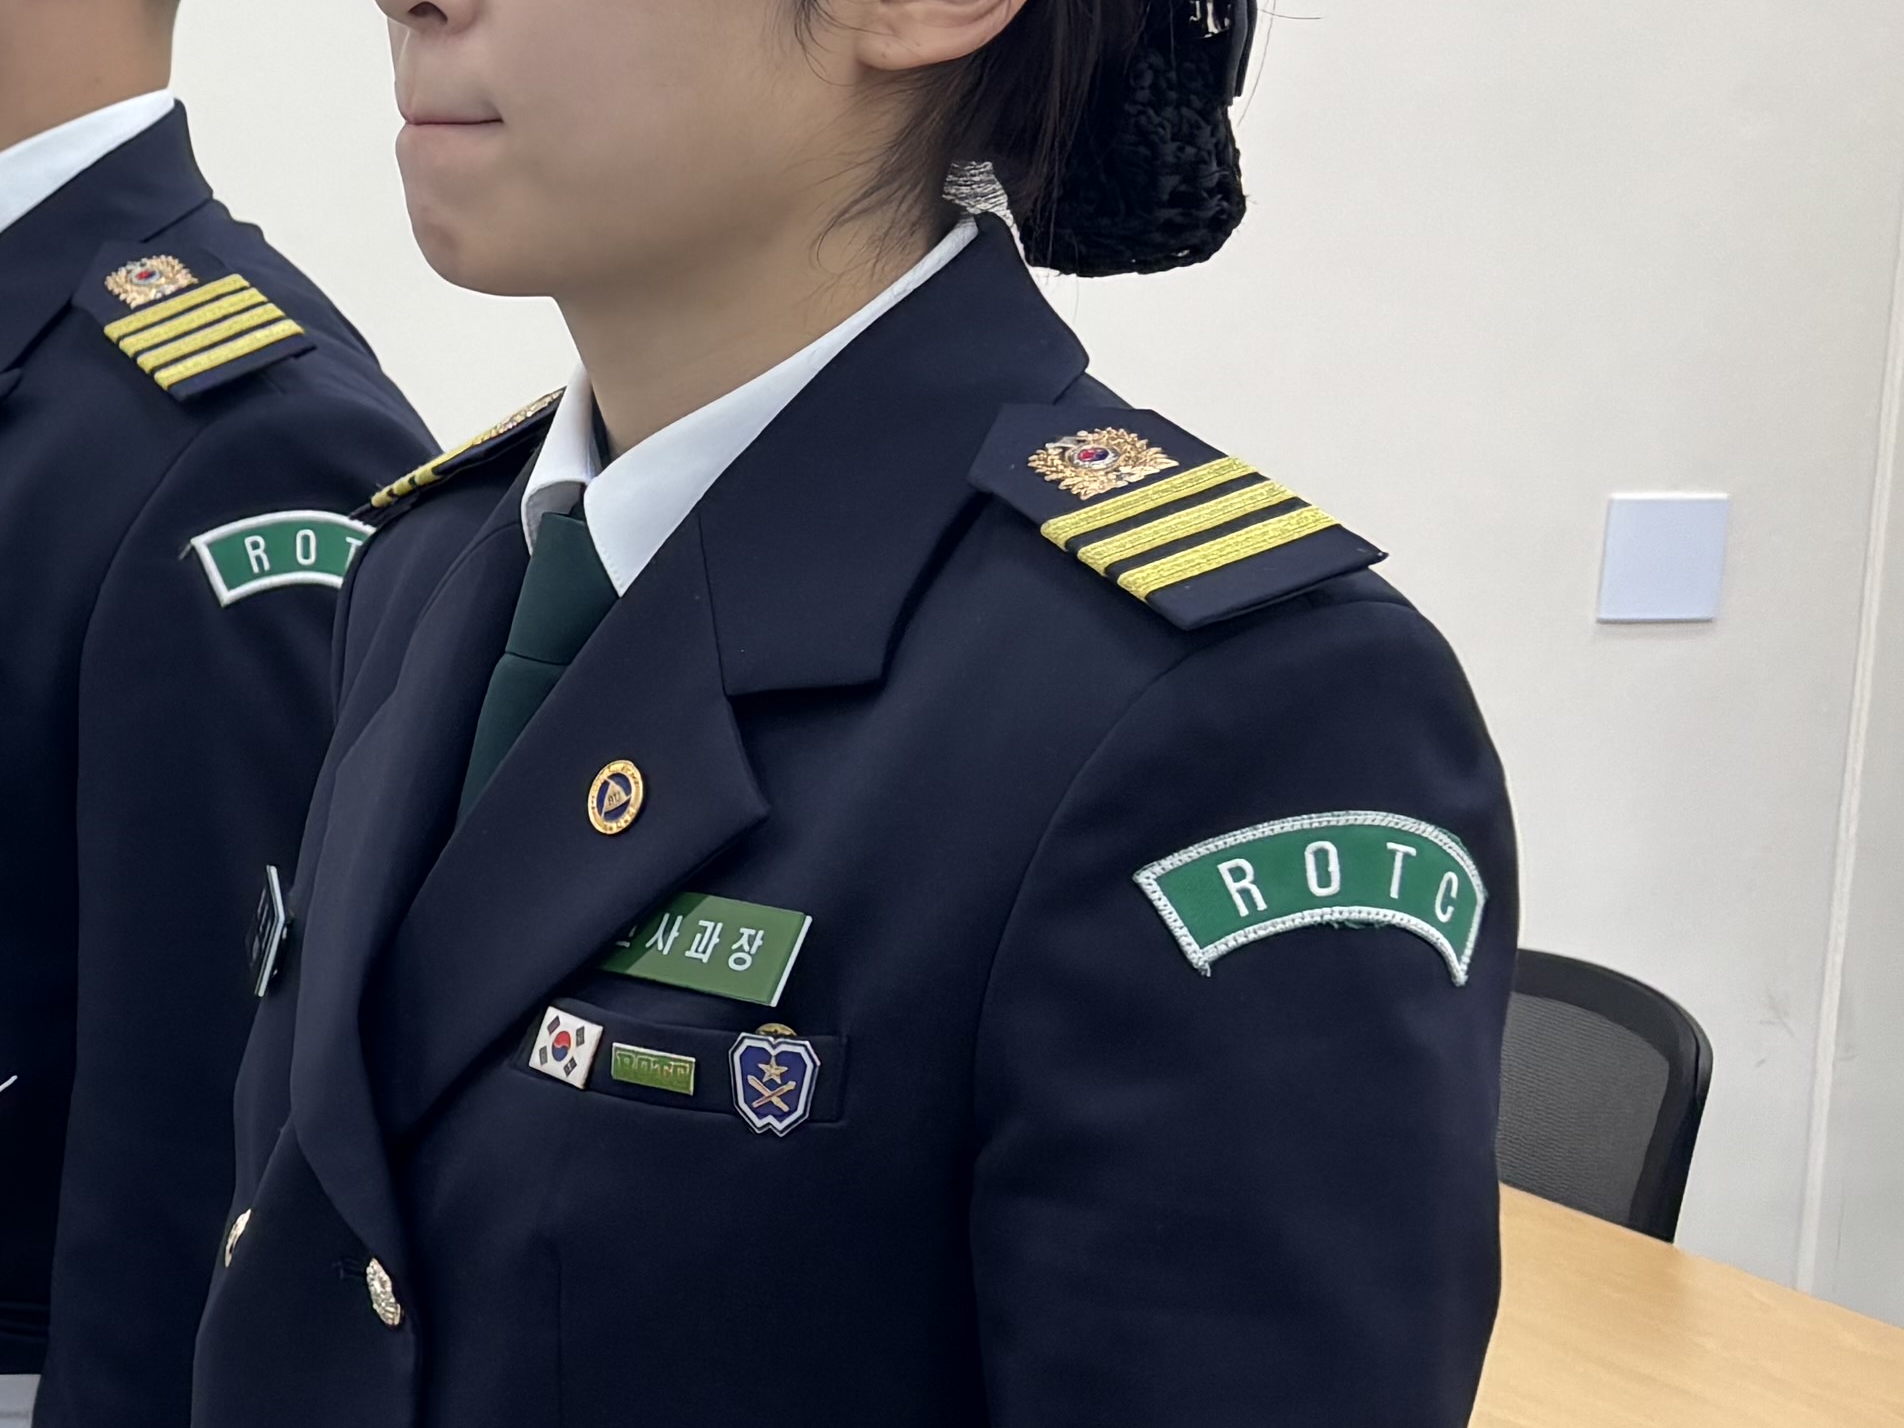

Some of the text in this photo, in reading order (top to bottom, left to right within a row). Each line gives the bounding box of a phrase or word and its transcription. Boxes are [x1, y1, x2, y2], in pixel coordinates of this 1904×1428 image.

[244, 529, 363, 574] ROT
[1217, 840, 1459, 923] ROTC
[615, 912, 765, 971] 사과장
